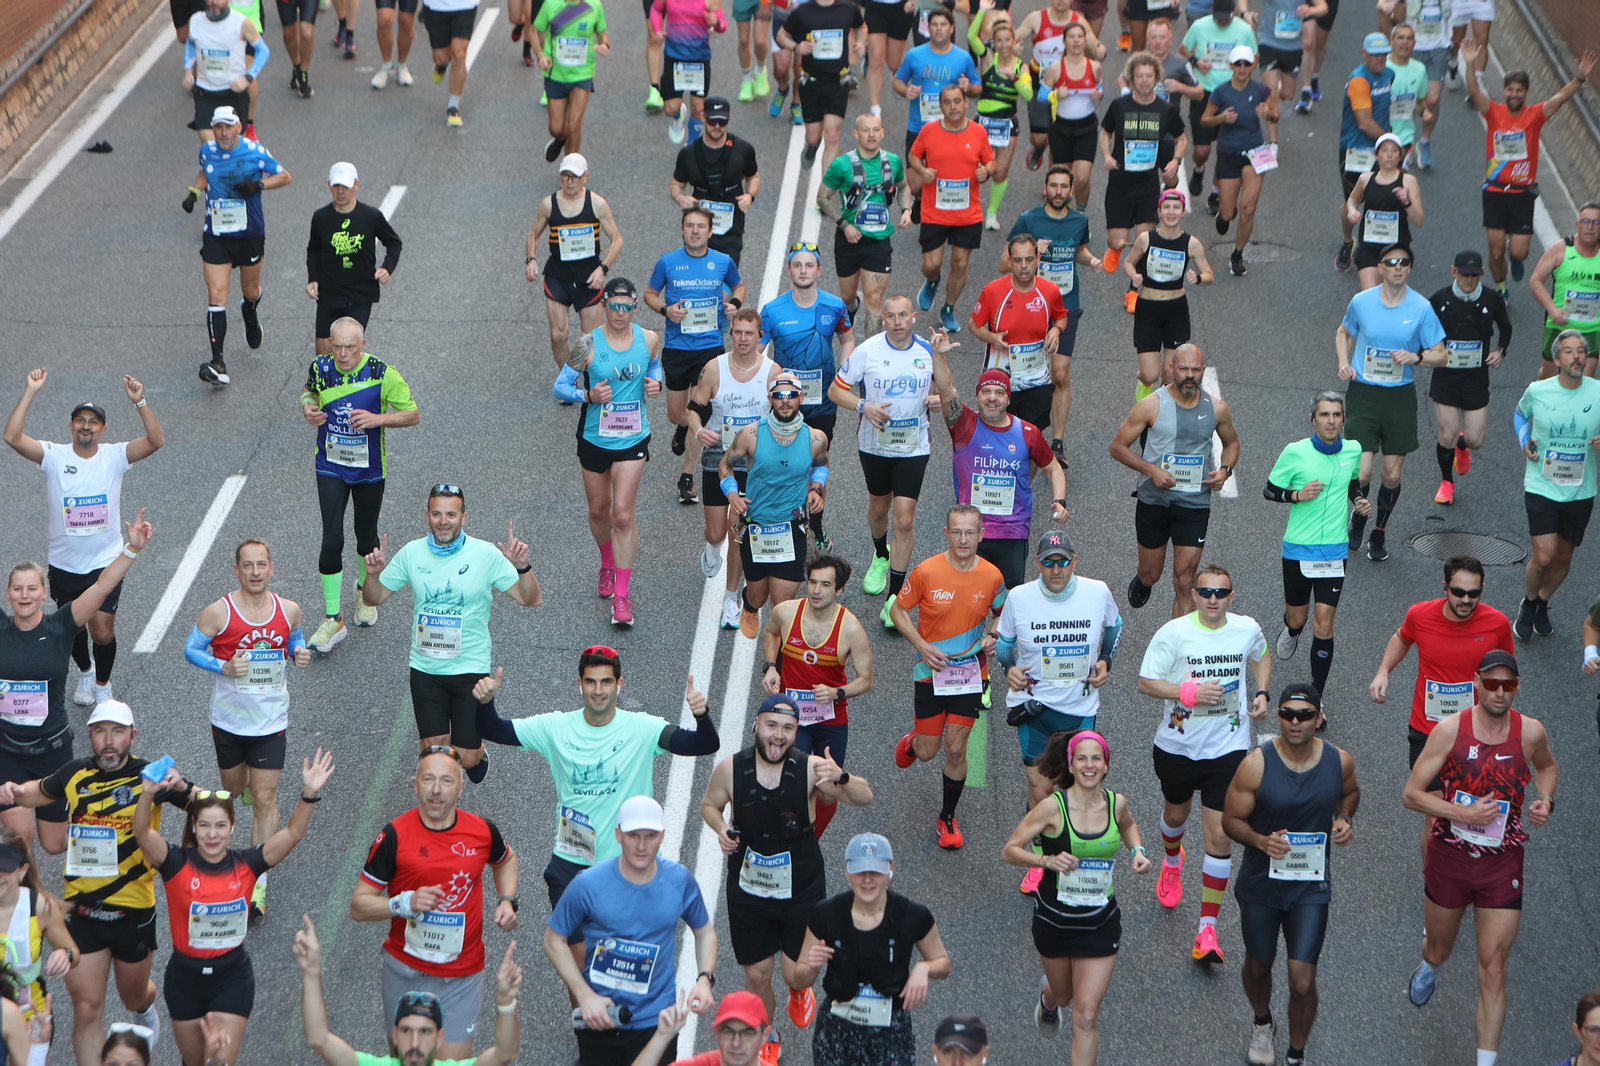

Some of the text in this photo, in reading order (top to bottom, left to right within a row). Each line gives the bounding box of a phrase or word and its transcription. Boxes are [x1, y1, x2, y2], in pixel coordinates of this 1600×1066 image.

[922, 64, 952, 81] RUN
[1124, 120, 1160, 131] RUN UTREG
[1022, 344, 1042, 352] ZURICH
[609, 360, 643, 381] A&D
[873, 375, 930, 395] arregui
[980, 379, 1007, 391] WONG
[616, 402, 636, 410] ZURICH
[729, 400, 762, 411] Marathon
[736, 417, 758, 425] ZURICH
[892, 419, 914, 427] ZURICH
[329, 425, 365, 436] BOLLENE
[339, 437, 363, 446] ZURICH
[1177, 457, 1200, 465] ZURICH
[984, 491, 1001, 499] 10921
[78, 497, 103, 505] ZURICH
[79, 511, 94, 519] 7718
[763, 526, 786, 534] ZURICH
[930, 588, 956, 601] TARN
[423, 607, 462, 617] SEVILLA'24
[430, 618, 456, 627] ZURICH
[1031, 620, 1091, 632] Los RUNNING
[238, 628, 284, 649] ITALIA
[429, 632, 444, 640] 8885
[1033, 634, 1088, 644] del PLADUR
[1058, 646, 1086, 656] ZURICH
[255, 652, 279, 661] ZURICH
[1204, 653, 1243, 665] RUNNING
[1058, 662, 1074, 670] 9581
[252, 667, 271, 675] 10396
[949, 669, 965, 677] 8472
[1191, 667, 1240, 679] del PLADUR
[249, 677, 274, 685] ROBERTO
[13, 683, 41, 693] ZURICH
[1222, 684, 1235, 693] RICH
[1440, 686, 1467, 695] ZURICH
[1439, 699, 1459, 707] 10938
[15, 708, 29, 716] LENA
[802, 706, 818, 714] 8254
[574, 813, 590, 825] ZURI
[82, 829, 110, 838] ZURICH
[1291, 836, 1319, 845] ZURICH
[82, 846, 97, 854] 9768
[80, 857, 99, 865] AARON
[757, 858, 785, 867] ZURICH
[1081, 860, 1109, 869] ZURICH
[1285, 862, 1310, 870] GABRIEL
[757, 871, 773, 880] 9483
[211, 902, 242, 914] ZURICH
[210, 920, 229, 929] 9650
[427, 915, 458, 925] ZURICH
[200, 927, 237, 938] ANA KARINE
[422, 930, 446, 941] 11012
[423, 942, 441, 951] RAFA
[618, 943, 650, 957] ZURICH
[612, 957, 635, 972] 12514
[605, 967, 637, 981] ANDREAS
[850, 1014, 869, 1024] SOFIA
